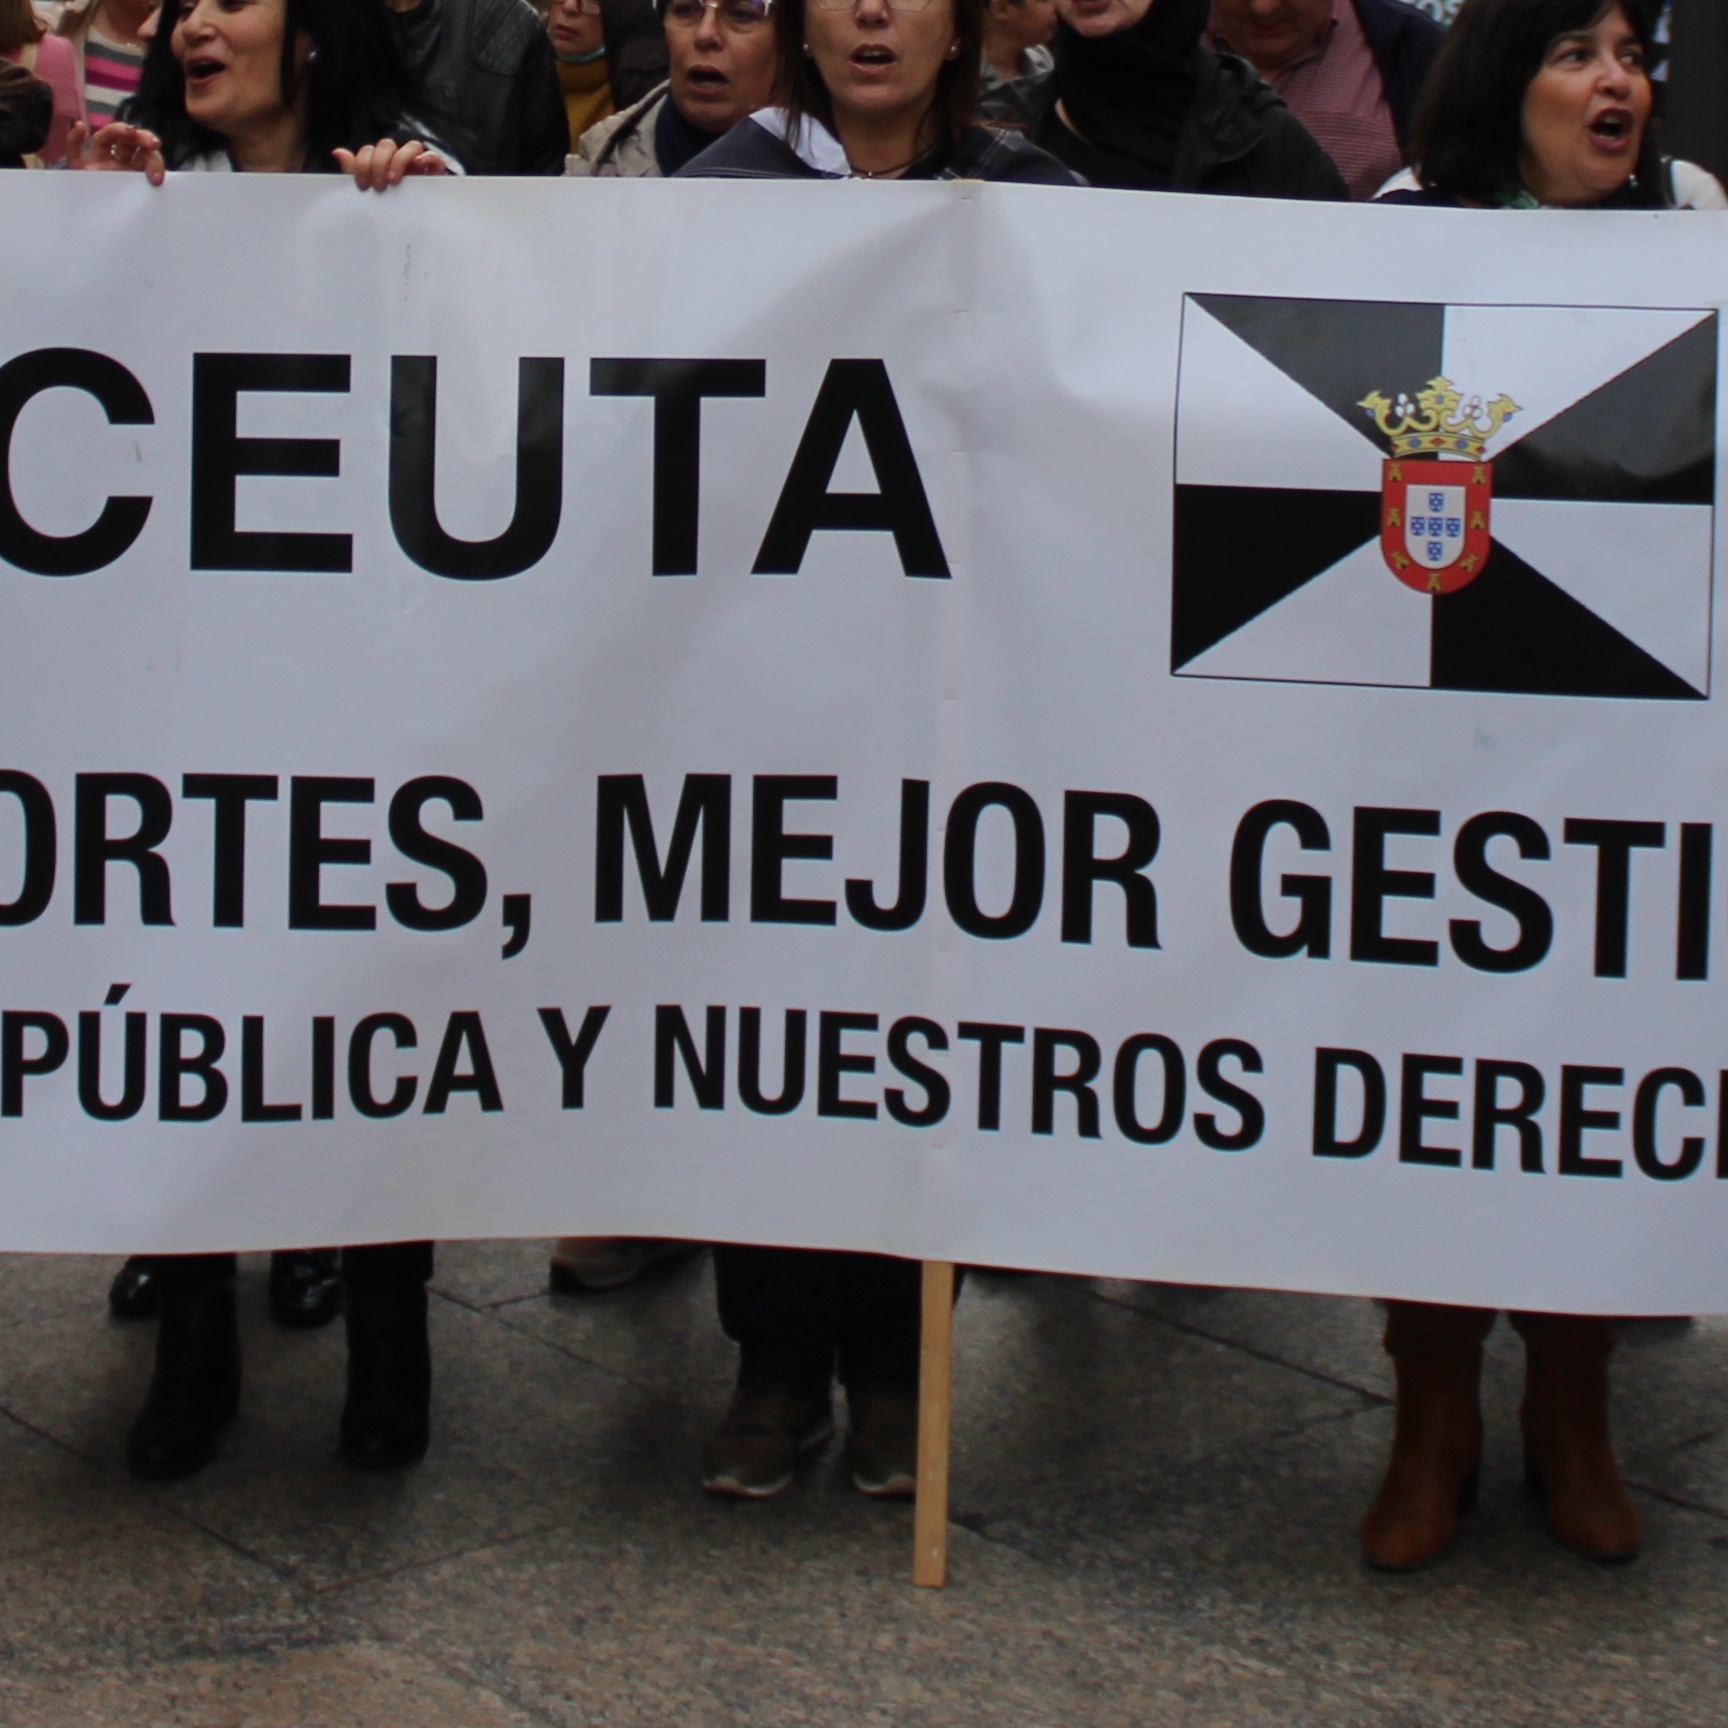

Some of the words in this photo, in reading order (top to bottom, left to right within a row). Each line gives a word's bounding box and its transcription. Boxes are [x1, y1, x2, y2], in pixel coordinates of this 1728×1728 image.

[595, 773, 1162, 950] MEJOR
[0, 983, 504, 1123] PÚBLICA
[536, 1005, 612, 1110] Y
[653, 1004, 1265, 1152] NUESTROS
